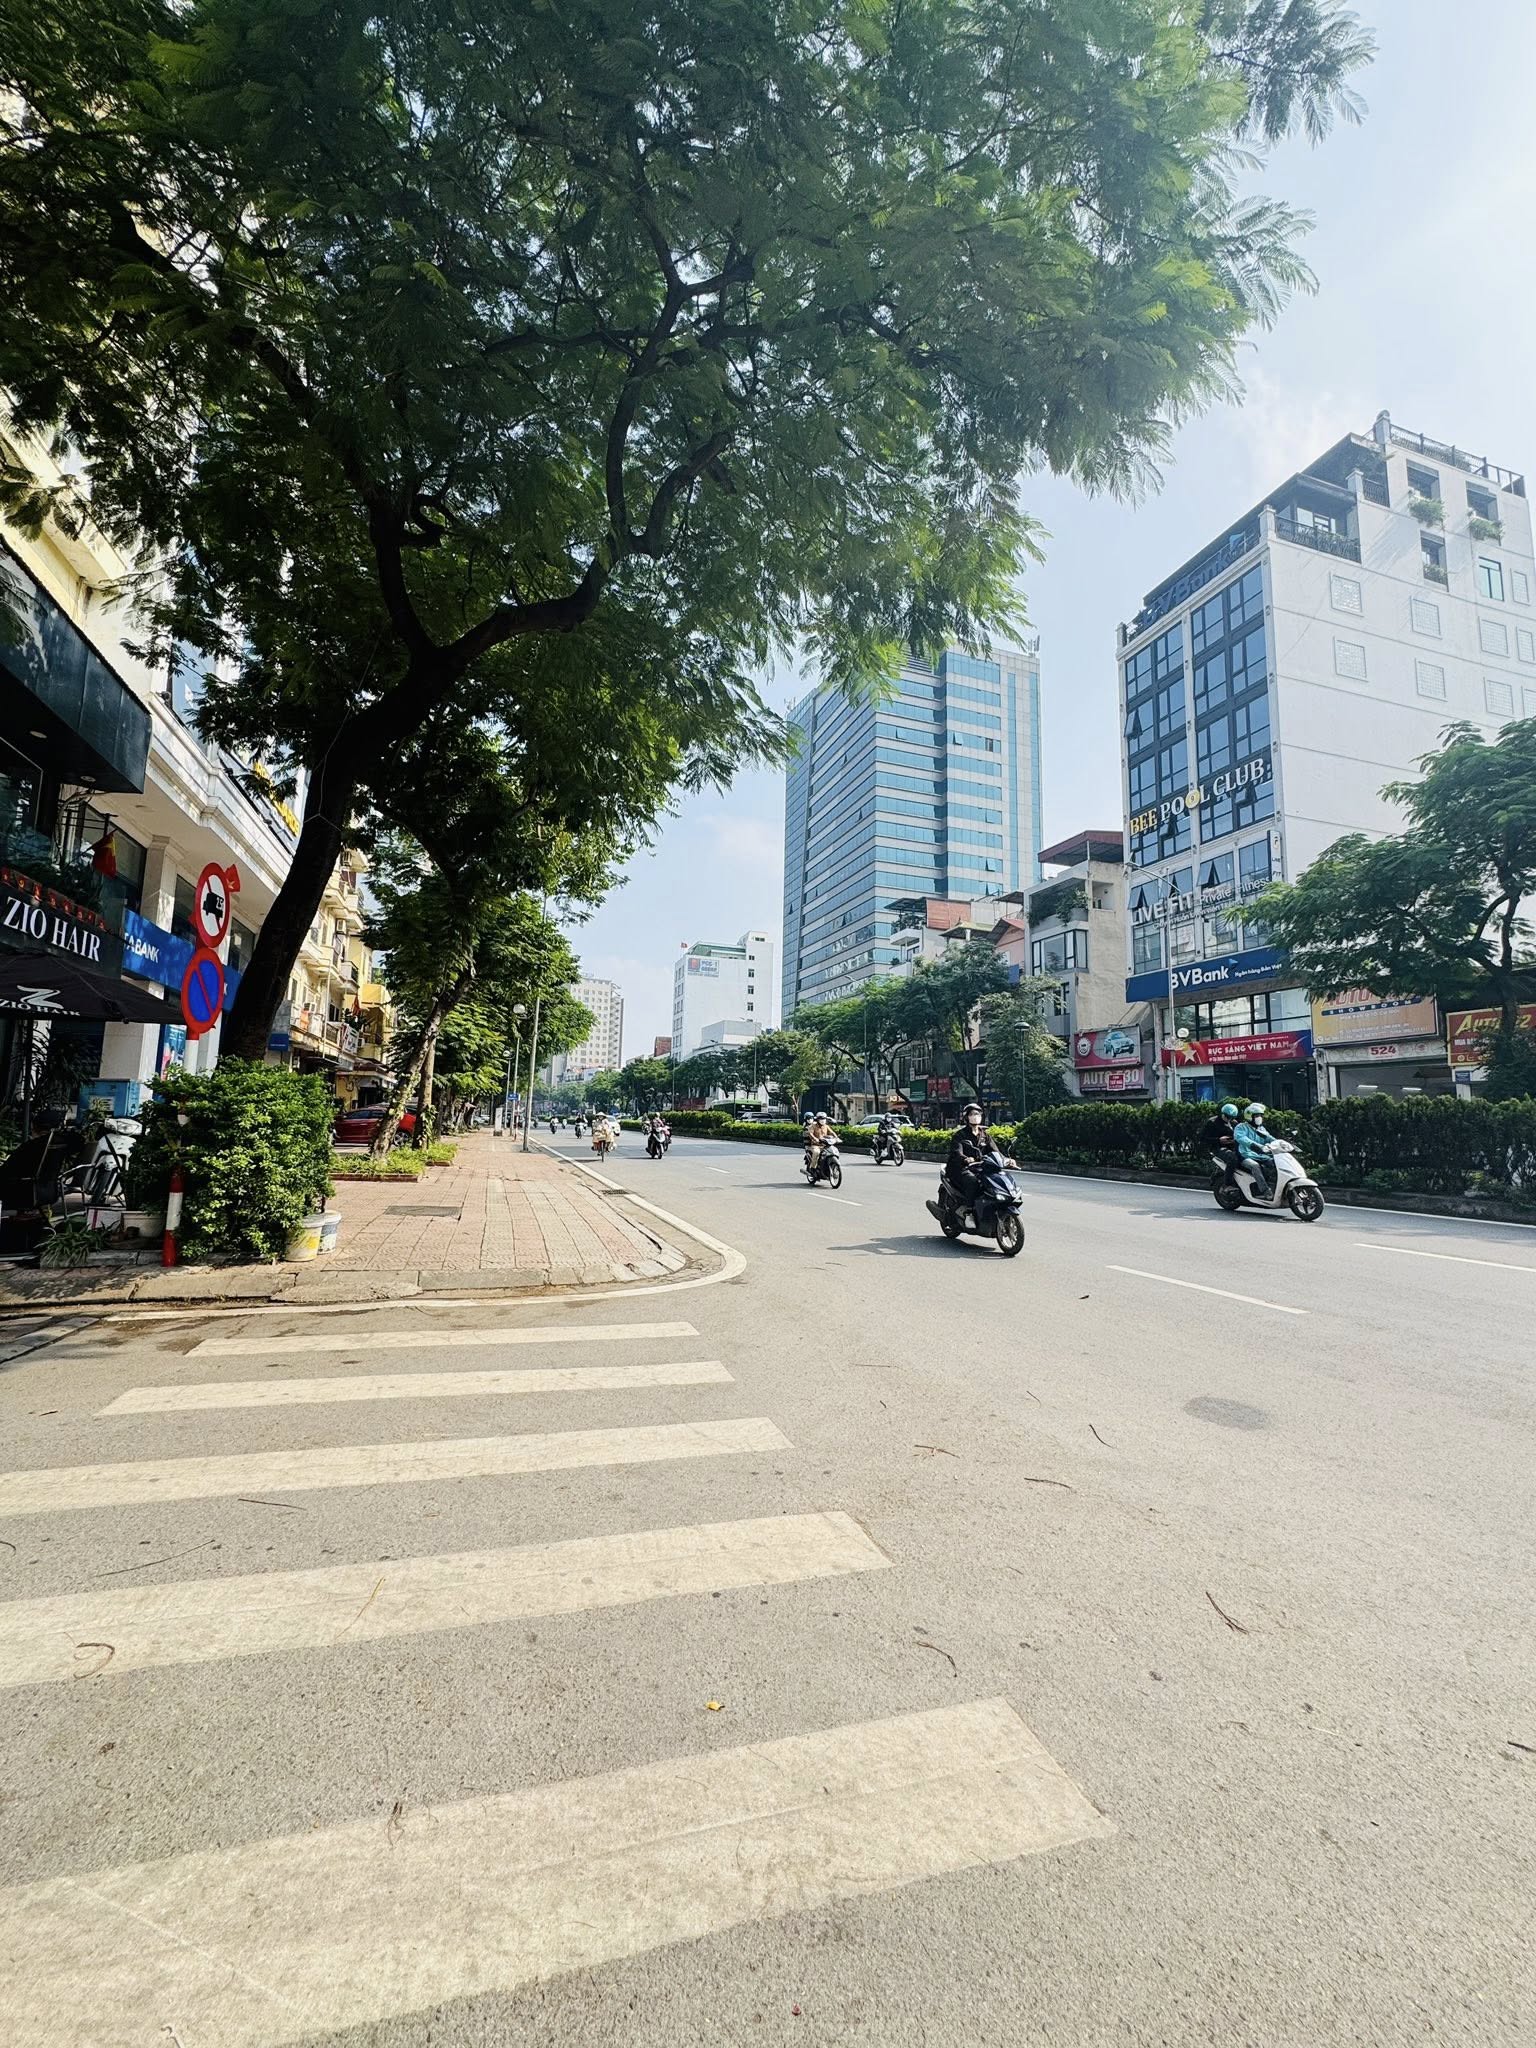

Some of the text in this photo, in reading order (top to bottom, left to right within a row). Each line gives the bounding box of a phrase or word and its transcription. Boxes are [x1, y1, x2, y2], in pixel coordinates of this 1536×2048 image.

[1130, 808, 1157, 837] BEE
[1213, 758, 1265, 796] CLUB
[1131, 899, 1167, 925] LIVE
[1170, 892, 1194, 914] FIT
[1200, 889, 1232, 905] Private
[3, 896, 100, 962] ZIO HAIR
[1170, 966, 1230, 989] BVBank
[0, 999, 31, 1010] ZIO
[1248, 1041, 1268, 1051] VIỆT
[1270, 1041, 1289, 1049] NAM
[1370, 1045, 1397, 1055] 524
